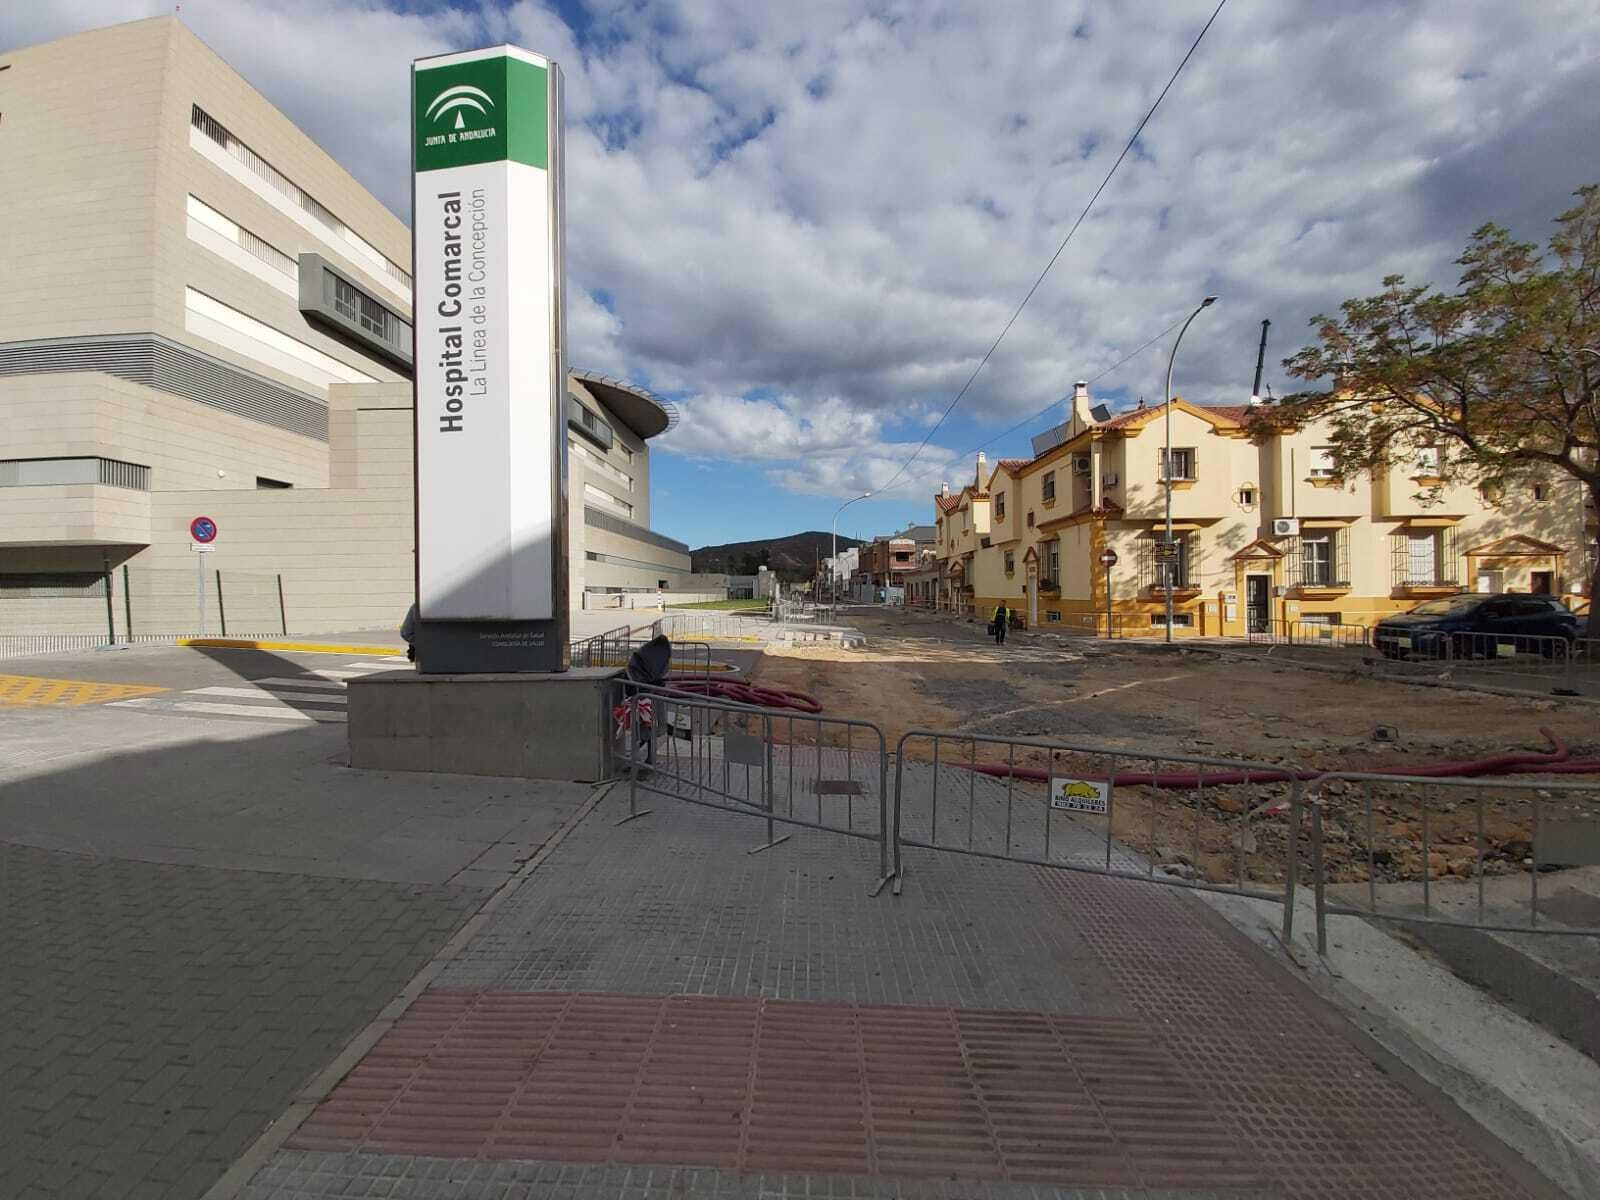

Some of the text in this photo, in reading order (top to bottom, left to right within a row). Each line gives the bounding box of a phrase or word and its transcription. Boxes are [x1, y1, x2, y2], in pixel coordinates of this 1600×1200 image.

[425, 136, 446, 146] JUNTA
[448, 133, 458, 143] DE
[468, 188, 488, 282] Concepción
[470, 287, 485, 301] la
[438, 191, 467, 433] Hospital Comarcal
[470, 304, 486, 324] de
[470, 378, 488, 397] La
